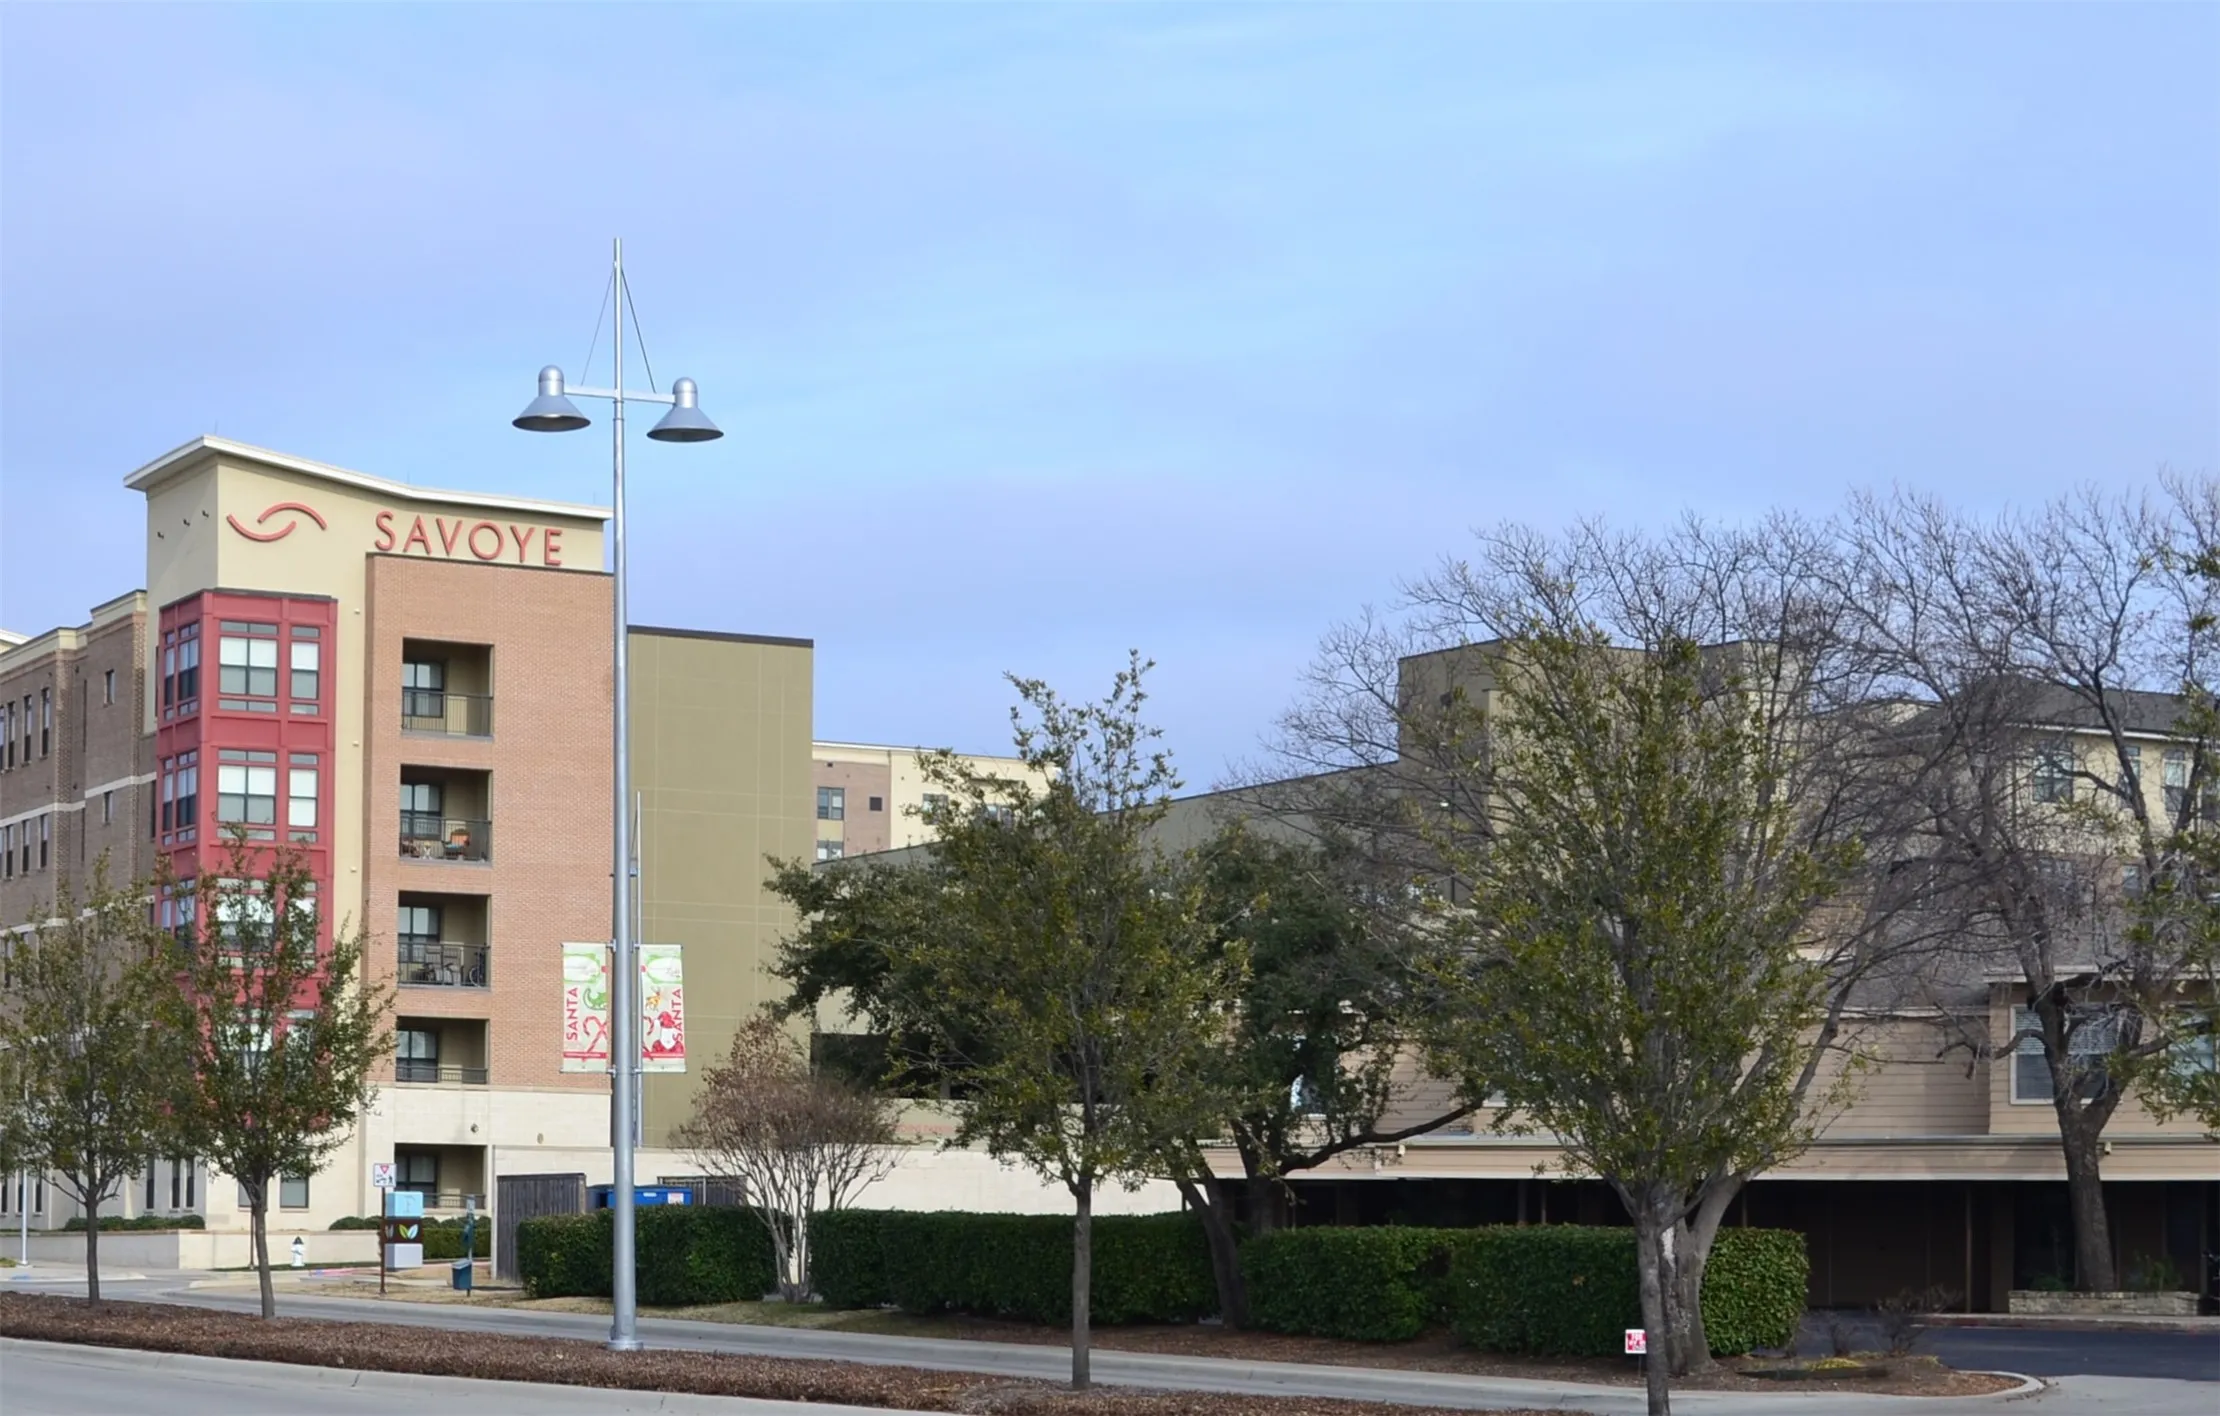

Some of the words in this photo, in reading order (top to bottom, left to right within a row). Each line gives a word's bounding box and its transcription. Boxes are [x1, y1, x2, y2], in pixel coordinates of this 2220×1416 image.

[375, 510, 562, 566] SAVOYE
[566, 987, 578, 1041] SANTA
[671, 988, 683, 1041] SANTA
